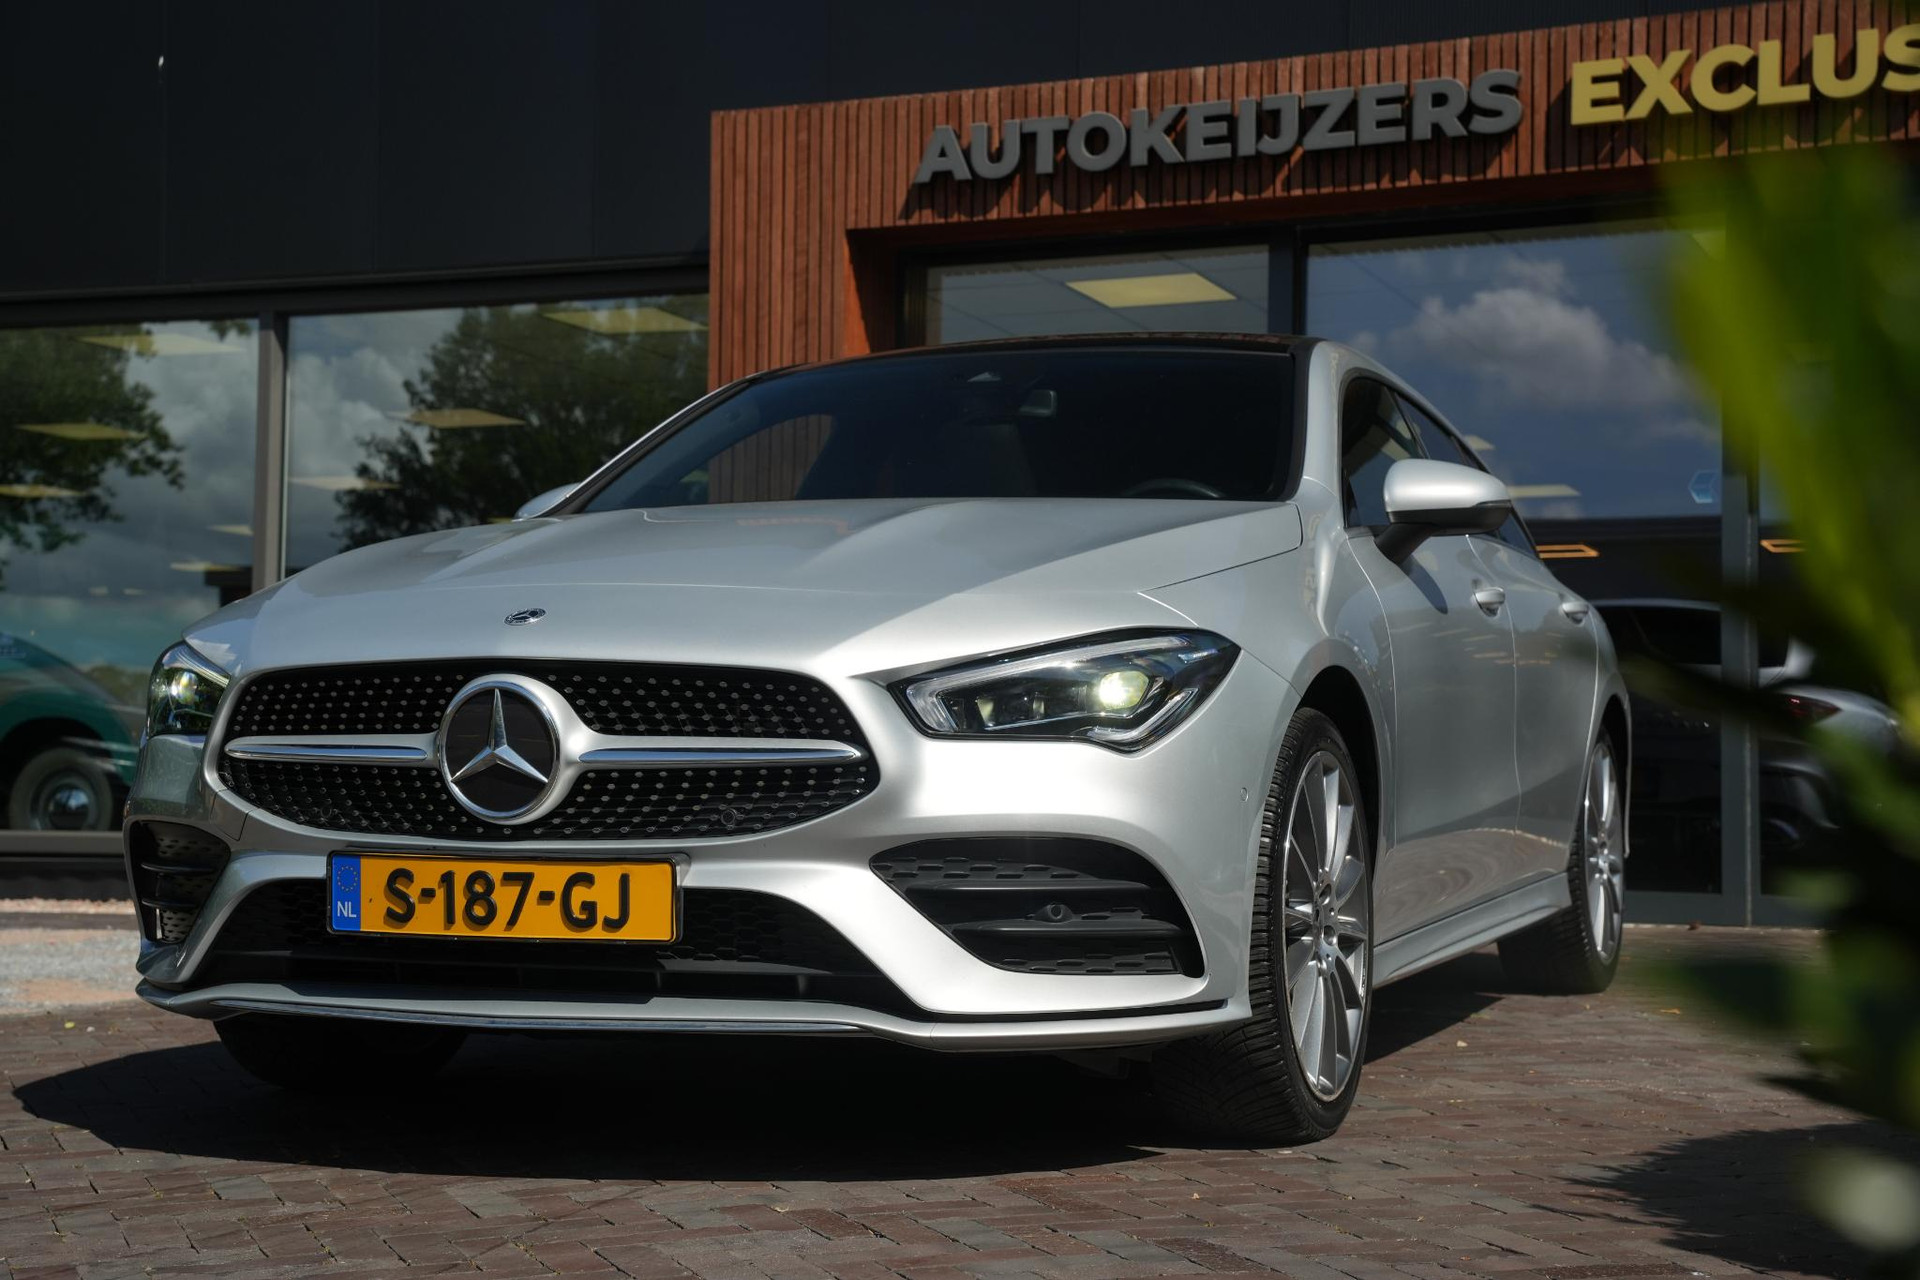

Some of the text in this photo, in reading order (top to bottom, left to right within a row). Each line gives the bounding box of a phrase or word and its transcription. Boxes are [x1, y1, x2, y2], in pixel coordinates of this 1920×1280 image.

[914, 69, 1523, 184] AUTOKEIJZERS
[337, 900, 357, 918] NL
[385, 867, 631, 930] S-187-GJ
